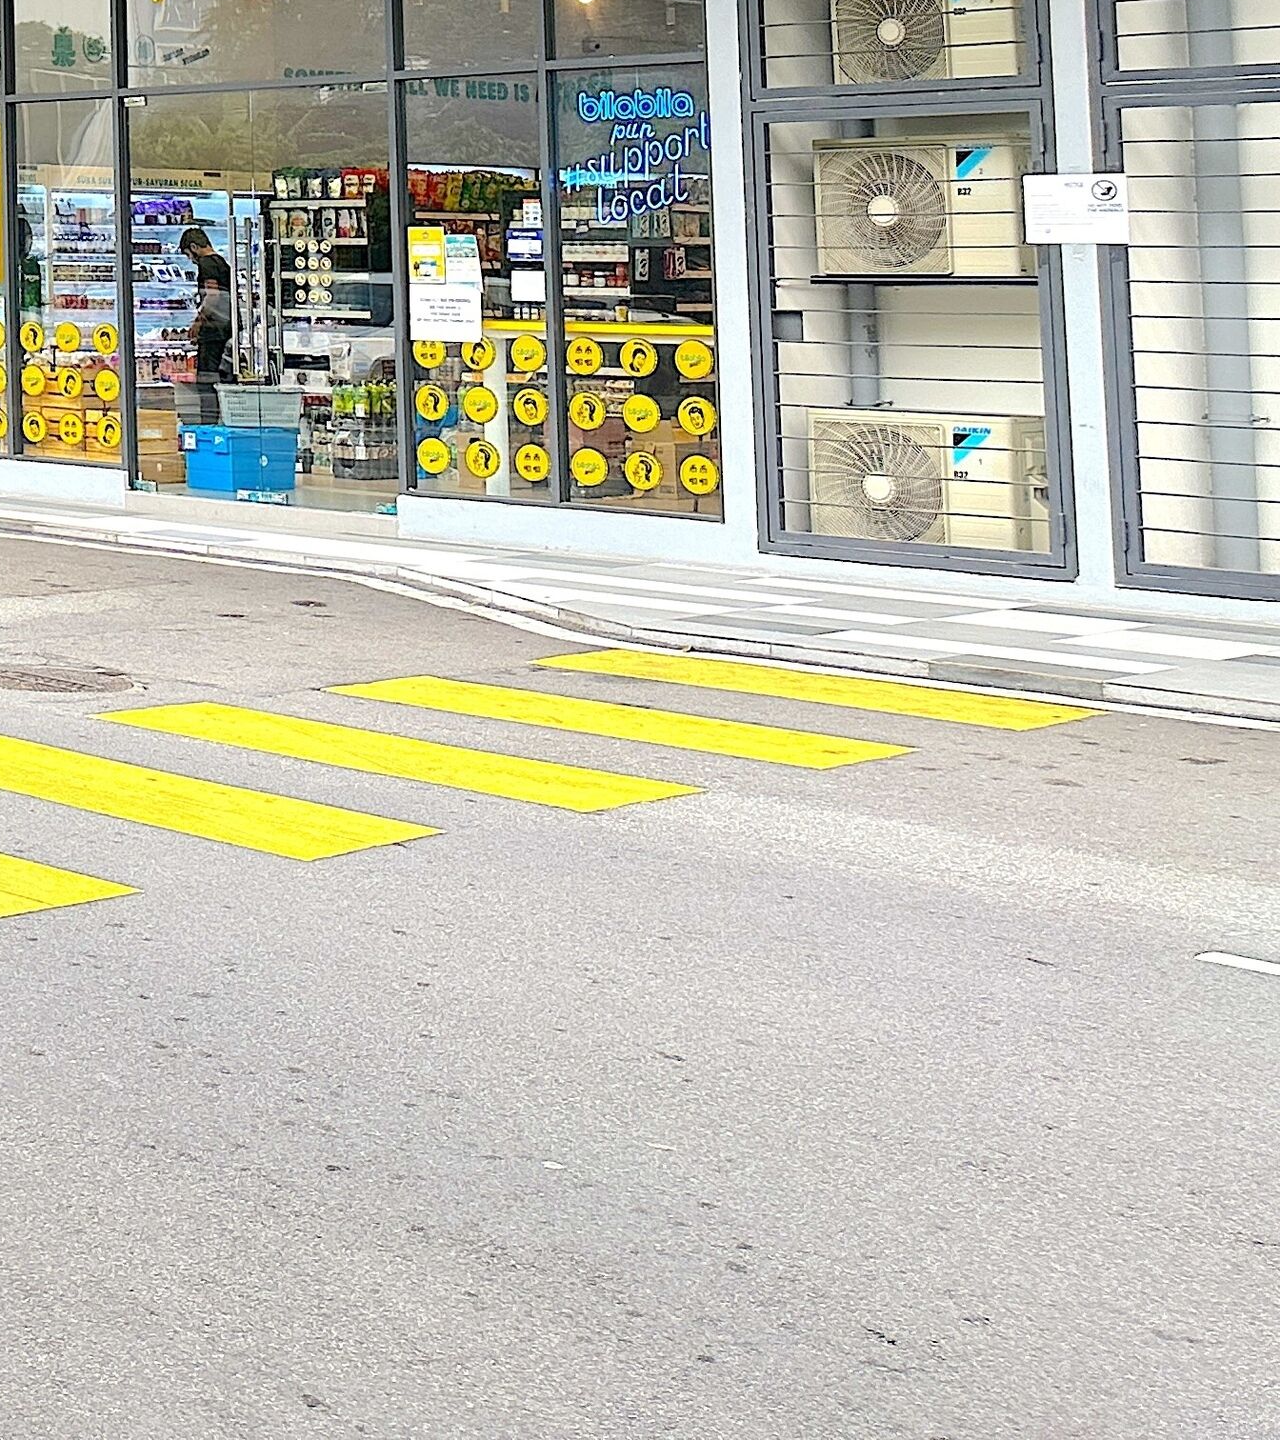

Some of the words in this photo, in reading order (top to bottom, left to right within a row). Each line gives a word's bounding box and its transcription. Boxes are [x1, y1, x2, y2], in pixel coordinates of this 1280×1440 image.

[434, 78, 461, 98] WE
[465, 80, 509, 101] NEED
[513, 83, 531, 102] IS
[578, 88, 694, 122] bilabila
[611, 121, 655, 145] pun
[563, 112, 711, 193] #support
[98, 176, 113, 185] SUK
[597, 163, 689, 225] local
[952, 426, 991, 435] DAIKIN
